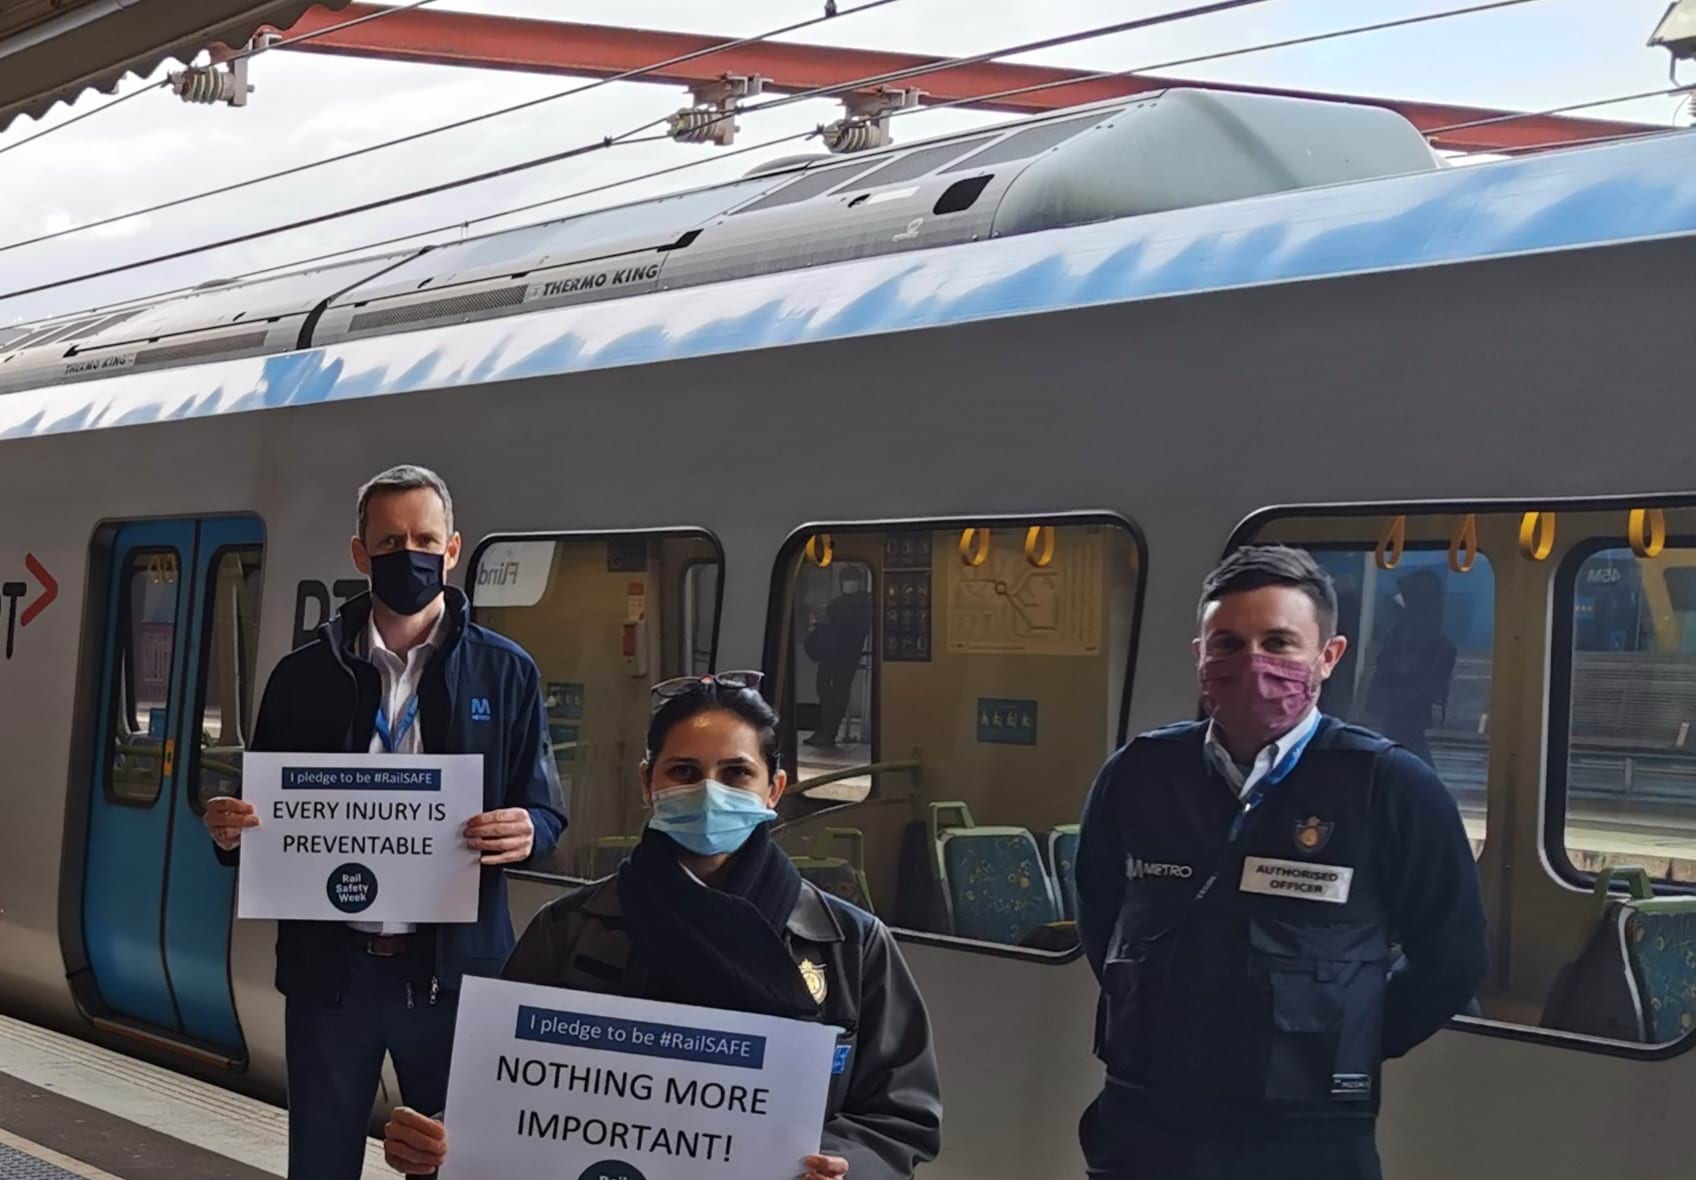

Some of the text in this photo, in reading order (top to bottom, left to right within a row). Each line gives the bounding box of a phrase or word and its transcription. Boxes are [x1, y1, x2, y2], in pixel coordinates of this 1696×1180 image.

[543, 264, 659, 296] THERMO KING
[296, 771, 337, 786] pledge
[340, 773, 353, 784] to
[356, 771, 371, 784] be
[374, 772, 433, 785] #RailSAFE
[272, 800, 446, 822] EVERY INJURY IS
[282, 834, 433, 856] PREVENTABLE
[342, 873, 361, 884] Rail
[1256, 864, 1338, 882] AUTHORISED
[335, 882, 369, 896] Safety
[1269, 879, 1323, 894] OFFICER
[338, 891, 366, 903] Week
[529, 1014, 751, 1058] I pledge to be #RailSAFE
[496, 1055, 770, 1116] NOTHING MORE
[516, 1109, 734, 1162] IMPORTANT!
